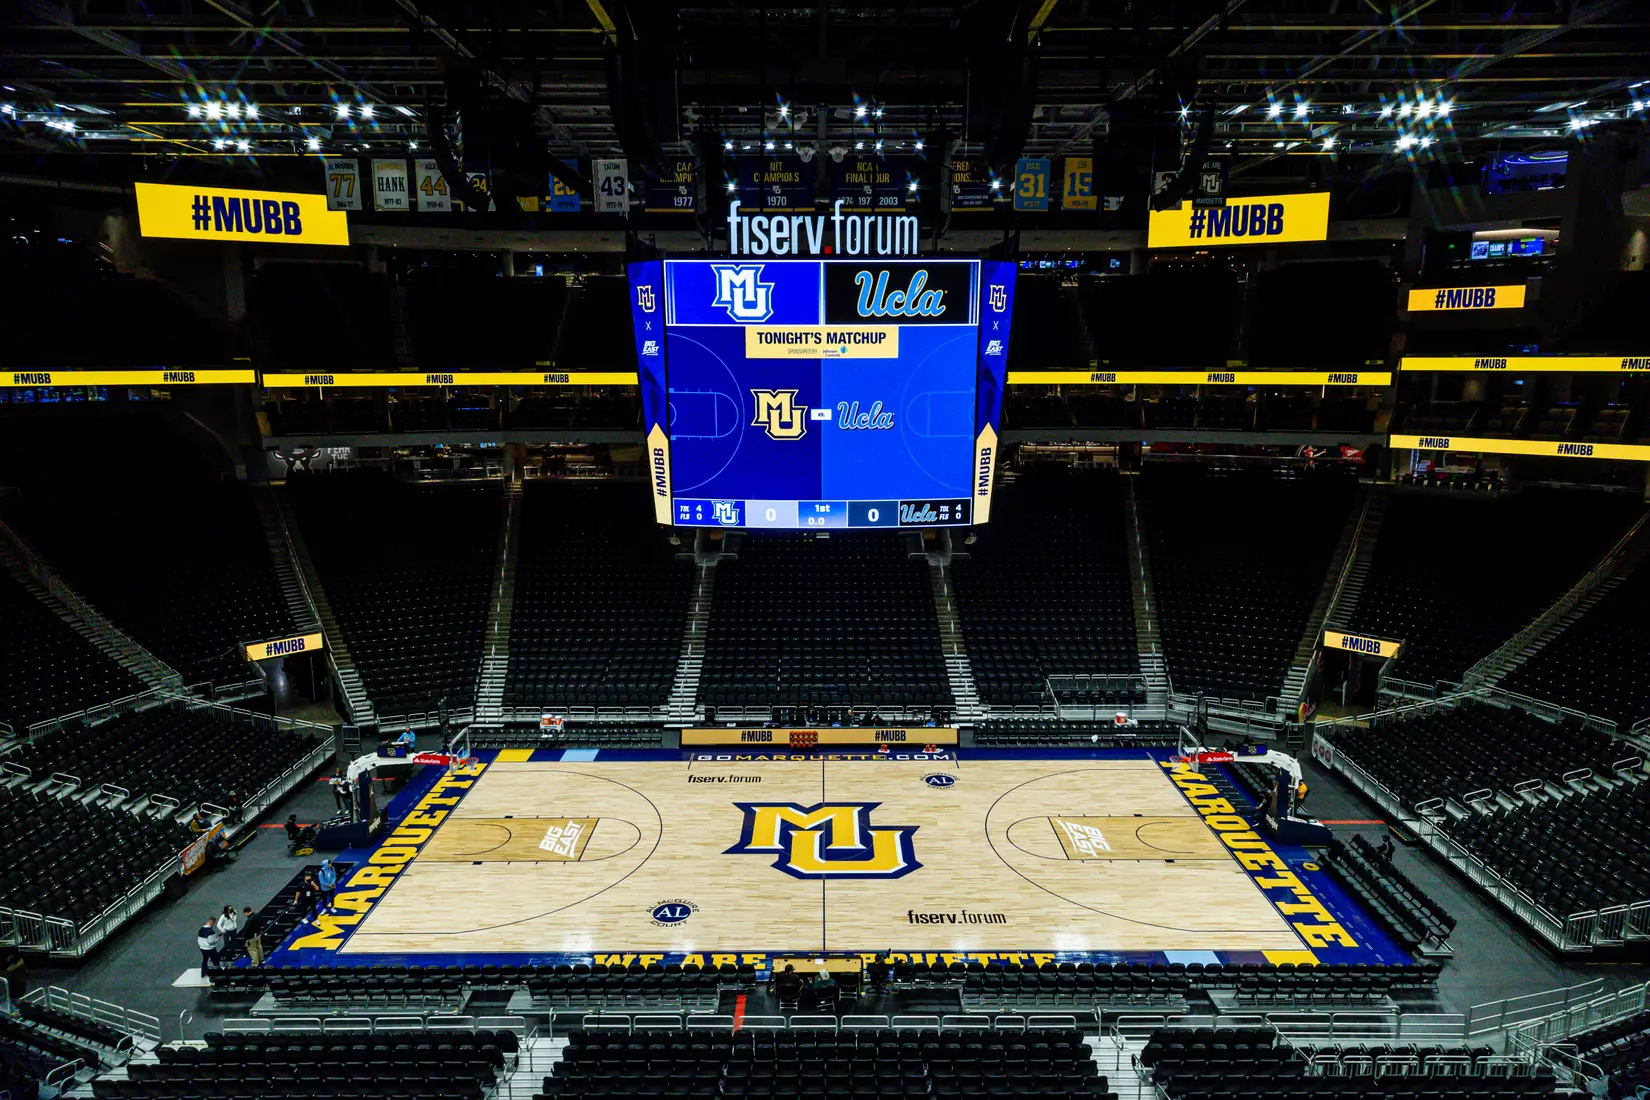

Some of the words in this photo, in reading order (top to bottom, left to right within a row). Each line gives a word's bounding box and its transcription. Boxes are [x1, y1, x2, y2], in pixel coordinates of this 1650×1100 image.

[604, 162, 620, 171] TATUM
[770, 161, 783, 172] NIT
[857, 161, 879, 172] NCA
[329, 173, 355, 198] 77
[377, 176, 405, 192] HANK
[420, 175, 447, 196] 44
[601, 176, 625, 196] 43
[1019, 173, 1046, 198] 31
[1068, 172, 1093, 197] 15
[1199, 172, 1224, 196] MU
[673, 196, 693, 207] 1977
[767, 196, 787, 206] 1970
[879, 196, 898, 206] 2003
[192, 194, 303, 236] #MUBB
[1189, 203, 1285, 239] #MUBB
[637, 285, 656, 313] MU
[710, 264, 776, 323] MU
[989, 284, 1007, 313] MU
[1435, 287, 1496, 309] #MUBB
[757, 331, 822, 345] TONIGHT'S
[826, 331, 887, 345] MATCHUP
[1473, 358, 1507, 370] #MUBB
[1621, 358, 1650, 370] #MUB
[13, 373, 51, 385] #MUBB
[163, 372, 195, 383] #MUBB
[304, 375, 335, 385] #MUBB
[426, 374, 454, 384] #MUBB
[543, 373, 570, 383] #MUBB
[1090, 373, 1117, 383] #MUBB
[1207, 373, 1235, 383] #MUBB
[1327, 373, 1358, 384] #MUBB
[750, 389, 809, 441] MU
[1418, 437, 1450, 449] #MUBB
[1556, 443, 1593, 456] #MUBB
[653, 447, 668, 497] #MUBB
[977, 446, 993, 497] #MUBB
[696, 504, 702, 512] 4
[711, 500, 740, 526] MU
[765, 508, 777, 521] 0
[815, 504, 830, 512] 1st
[867, 508, 880, 522] 0
[955, 504, 962, 512] 4
[808, 517, 825, 526] 0.0
[266, 637, 305, 657] #MUBB
[1341, 635, 1381, 654] #MUBB
[741, 730, 773, 742] #MUBB
[874, 729, 907, 742] #MUBB
[687, 774, 762, 784] fiserv.forum
[538, 825, 564, 852] BIG
[552, 820, 581, 856] EAST
[721, 802, 925, 880] MU
[1064, 821, 1098, 858] EAST
[1081, 824, 1112, 852] BIG
[287, 762, 488, 951] MARQUETTE
[1159, 761, 1360, 948] MARQUETTE
[655, 906, 689, 918] AL
[906, 909, 1008, 924] fiserv.forum
[650, 919, 688, 928] COURT
[593, 953, 665, 969] WE
[680, 953, 767, 970] ARE
